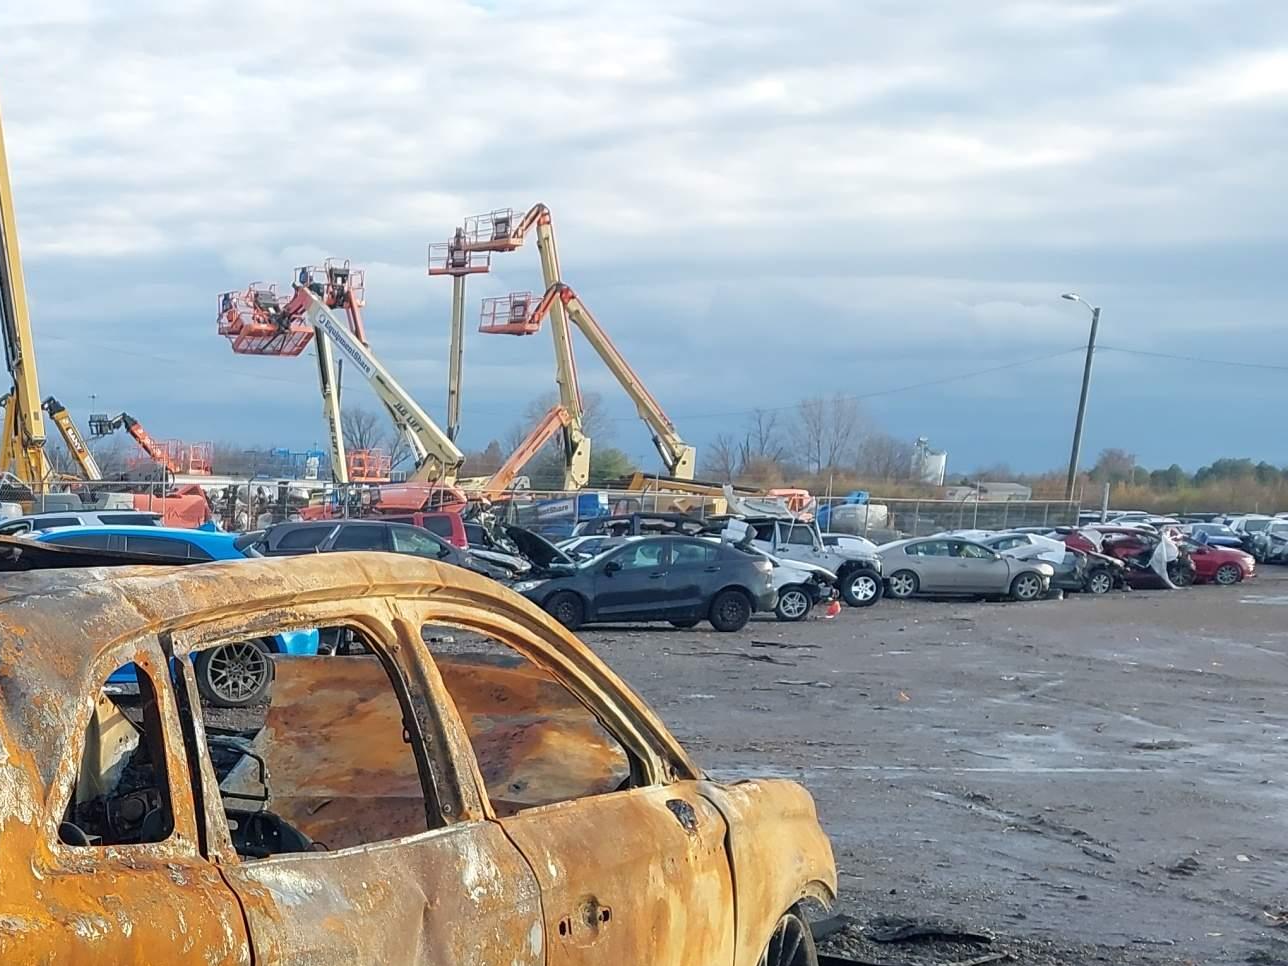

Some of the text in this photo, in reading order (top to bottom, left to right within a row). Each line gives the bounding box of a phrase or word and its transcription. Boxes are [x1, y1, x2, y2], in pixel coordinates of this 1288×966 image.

[324, 319, 371, 374] EquipmentShare
[393, 402, 423, 433] JLG LIFT
